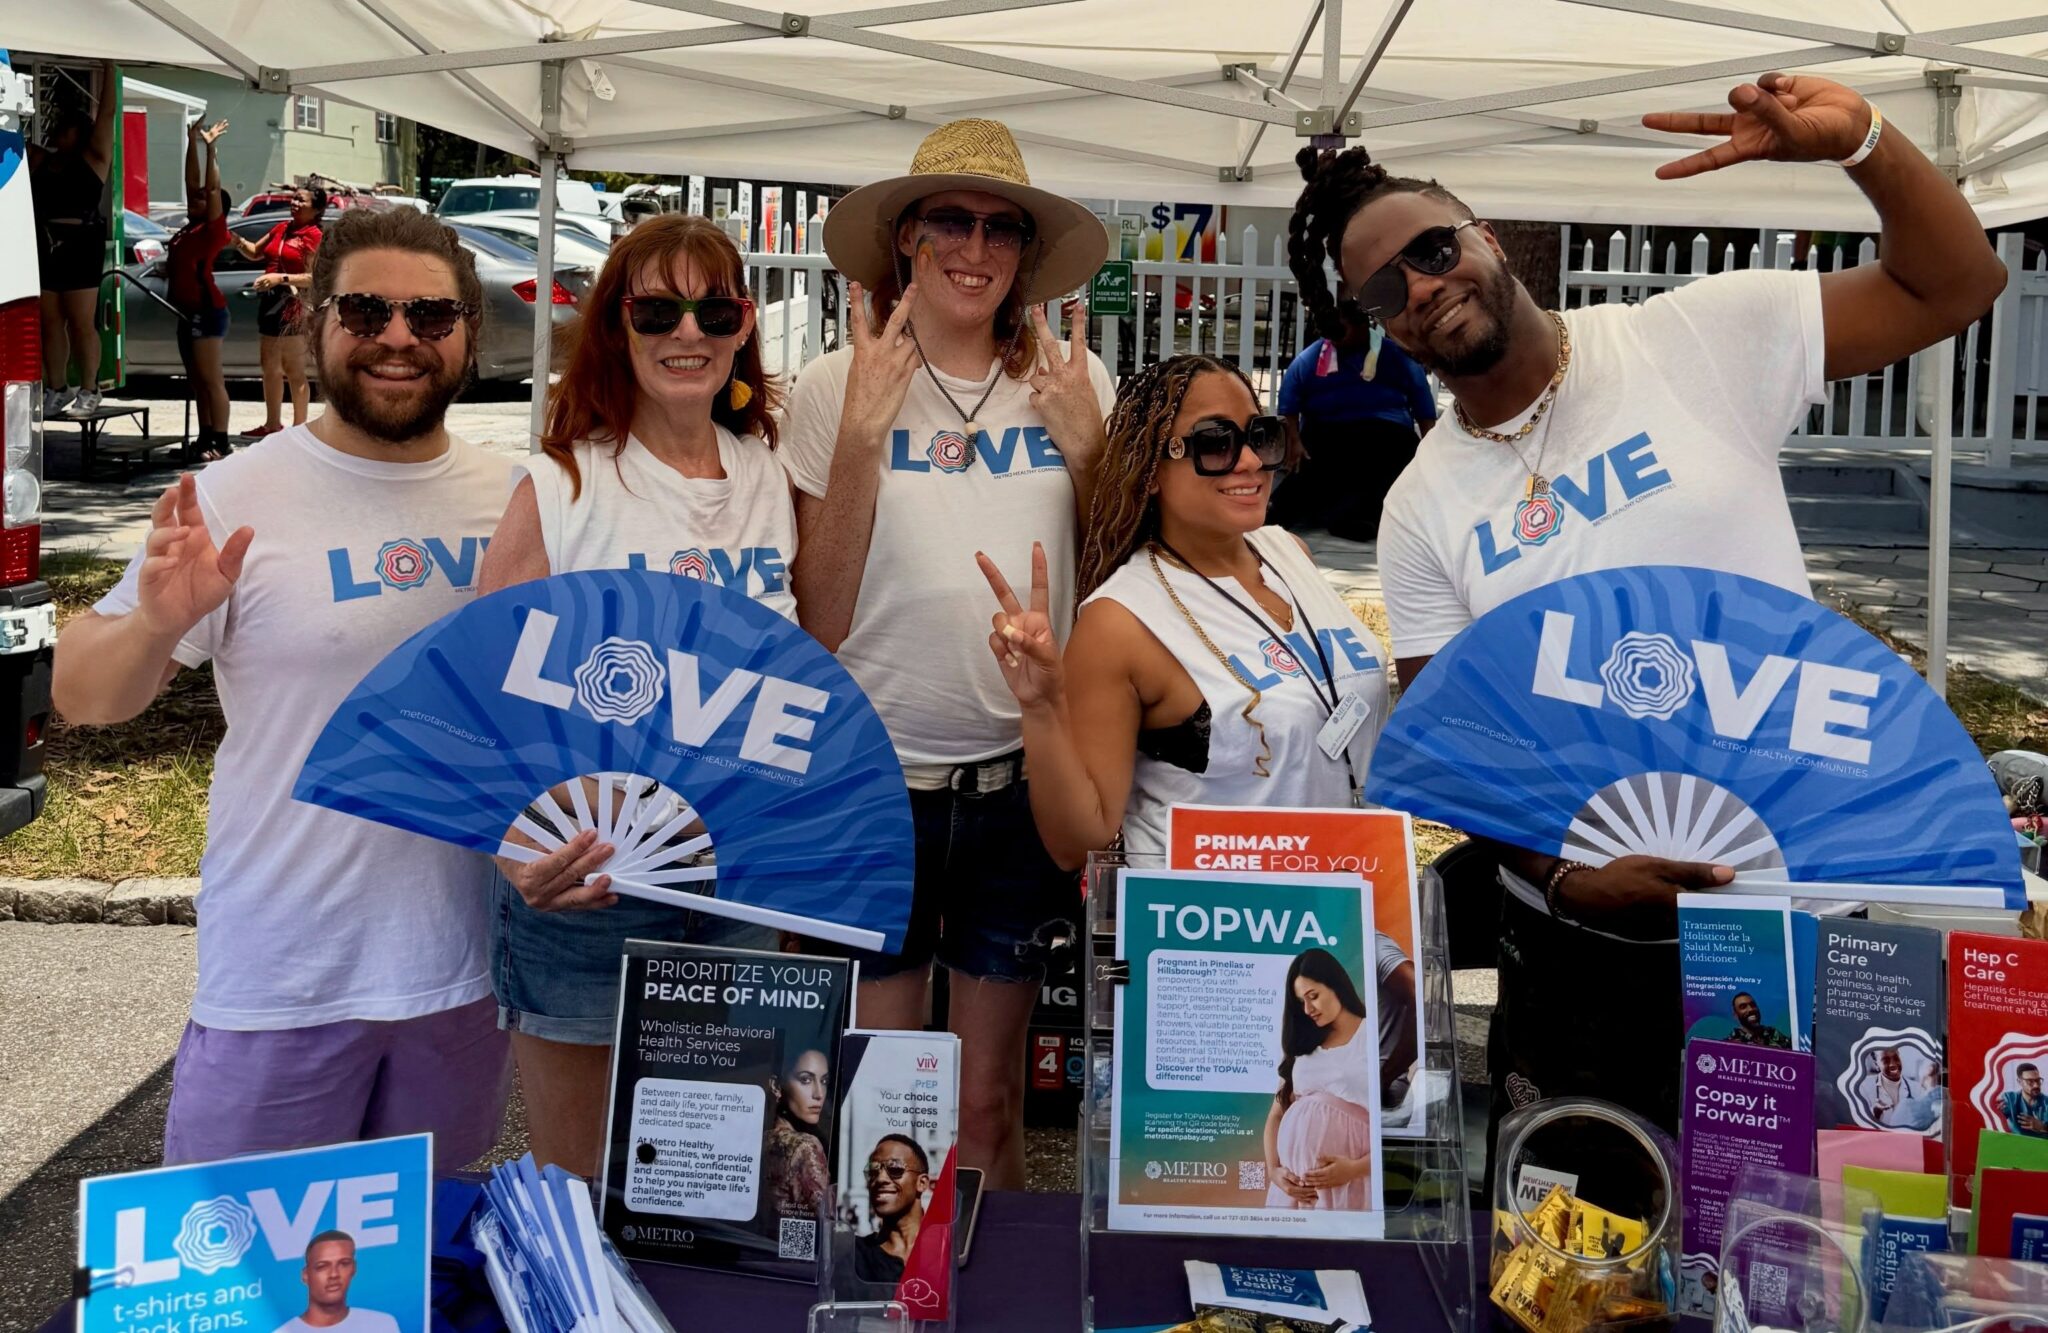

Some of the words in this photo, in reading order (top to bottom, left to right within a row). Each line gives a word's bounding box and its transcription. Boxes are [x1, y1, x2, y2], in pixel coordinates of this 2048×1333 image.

[1866, 129, 1878, 149] LOVE
[1151, 202, 1213, 258] $7
[891, 427, 1066, 474] LOVE
[1474, 431, 1672, 576] LOVE
[327, 537, 492, 602] LOV
[1228, 627, 1380, 691] LOVE
[502, 608, 829, 774] LOVE
[1532, 610, 1880, 764] LOVE
[400, 708, 496, 747] metrotampabay.org
[1442, 716, 1536, 749] metrotampabay.org
[669, 745, 700, 759] METRO
[702, 755, 741, 770] HEALTHY
[743, 765, 804, 786] COMMUNITIES
[1713, 739, 1747, 753] METRO
[1749, 749, 1794, 762] HEALTHY
[1795, 757, 1868, 777] COMMUNITIES
[1195, 834, 1310, 851] PRIMARY
[1195, 854, 1262, 870] CARE
[1270, 855, 1319, 871] FOR
[1327, 856, 1383, 873] YOU.
[1148, 903, 1338, 946] TOPWA.
[1683, 920, 1742, 930] Tratamiento
[1728, 933, 1739, 941] de
[1743, 933, 1750, 941] la
[1828, 933, 1898, 956] Primary
[1684, 942, 1710, 951] Salud
[1714, 944, 1746, 952] Mental
[1749, 946, 1754, 955] y
[1964, 948, 2001, 966] Hep
[2006, 953, 2019, 966] C
[1157, 958, 1198, 968] Pregnant
[1200, 959, 1208, 967] in
[1684, 953, 1737, 963] Addiciones
[1828, 950, 1868, 966] Care
[647, 960, 764, 983] PRIORITIZE
[771, 966, 832, 987] YOUR
[1157, 967, 1217, 977] Hillsborough?
[1827, 967, 1852, 978] Over
[1855, 971, 1872, 980] 100
[1876, 973, 1912, 987] health,
[1964, 965, 2005, 981] Care
[1827, 978, 1874, 992] wellness,
[1877, 985, 1897, 993] and
[1964, 982, 2007, 995] Hepatitis
[645, 982, 717, 1003] PEACE
[723, 987, 754, 1005] OF
[759, 989, 825, 1010] MIND.
[1827, 987, 1880, 1002] pharmacy
[1883, 995, 1926, 1007] services
[1964, 991, 1980, 999] Get
[1984, 993, 2001, 1002] free
[2005, 996, 2038, 1008] testing
[2041, 1000, 2047, 1008] &
[1826, 1007, 1871, 1020] settings.
[1827, 998, 1836, 1006] in
[1840, 999, 1921, 1016] state-of-the-art
[1964, 1000, 2013, 1012] treatment
[640, 1020, 702, 1035] Wholistic
[705, 1024, 775, 1039] Behavioral
[639, 1035, 682, 1048] Health
[686, 1038, 741, 1052] Services
[638, 1049, 691, 1064] Tailored
[694, 1053, 708, 1065] to
[711, 1054, 736, 1067] You
[916, 1057, 938, 1069] ViiV
[1039, 1052, 1058, 1073] 4
[1156, 1063, 1194, 1072] Discover
[1213, 1066, 1248, 1074] TOPWA
[1156, 1072, 1203, 1081] difference!
[1719, 1056, 1796, 1082] METRO
[915, 1080, 938, 1089] PrEP
[1718, 1075, 1746, 1083] HEALTHY
[1749, 1079, 1796, 1090] COMMUNITIES
[642, 1087, 680, 1098] Between
[683, 1090, 711, 1100] career,
[715, 1093, 744, 1104] family,
[880, 1090, 902, 1101] Your
[904, 1091, 938, 1102] choice
[1696, 1085, 1758, 1110] Copay
[1764, 1094, 1776, 1111] it
[640, 1098, 657, 1106] and
[659, 1099, 680, 1109] daily
[682, 1100, 698, 1110] life,
[699, 1103, 718, 1112] your
[721, 1104, 753, 1113] mental
[878, 1104, 900, 1113] Your
[902, 1106, 938, 1115] access
[640, 1108, 677, 1118] wellness
[679, 1110, 718, 1121] deserves
[886, 1117, 908, 1127] Your
[910, 1119, 938, 1129] voice
[639, 1117, 683, 1128] dedicated
[685, 1122, 713, 1131] space.
[1158, 1126, 1184, 1134] specific
[637, 1136, 646, 1144] At
[650, 1138, 677, 1147] Metro
[679, 1139, 715, 1151] Healthy
[1144, 1134, 1215, 1143] metrotampabay.org.
[635, 1157, 692, 1169] pessional,
[695, 1161, 752, 1174] confidential,
[718, 1154, 753, 1163] provide
[634, 1166, 652, 1174] and
[654, 1169, 723, 1181] compassionate
[726, 1174, 746, 1182] care
[1163, 1161, 1227, 1177] METRO
[632, 1186, 681, 1198] challenges
[684, 1190, 705, 1199] with
[633, 1176, 643, 1184] to
[645, 1176, 665, 1187] help
[667, 1179, 684, 1188] you
[687, 1181, 726, 1191] navigate
[729, 1184, 750, 1193] life's
[631, 1196, 685, 1207] confidence.
[115, 1172, 399, 1289] LOVE
[637, 1226, 694, 1243] METRO
[1880, 1230, 1900, 1293] Testing
[113, 1290, 207, 1323] t-shirts
[215, 1278, 263, 1301] and
[188, 1310, 248, 1331] fans.
